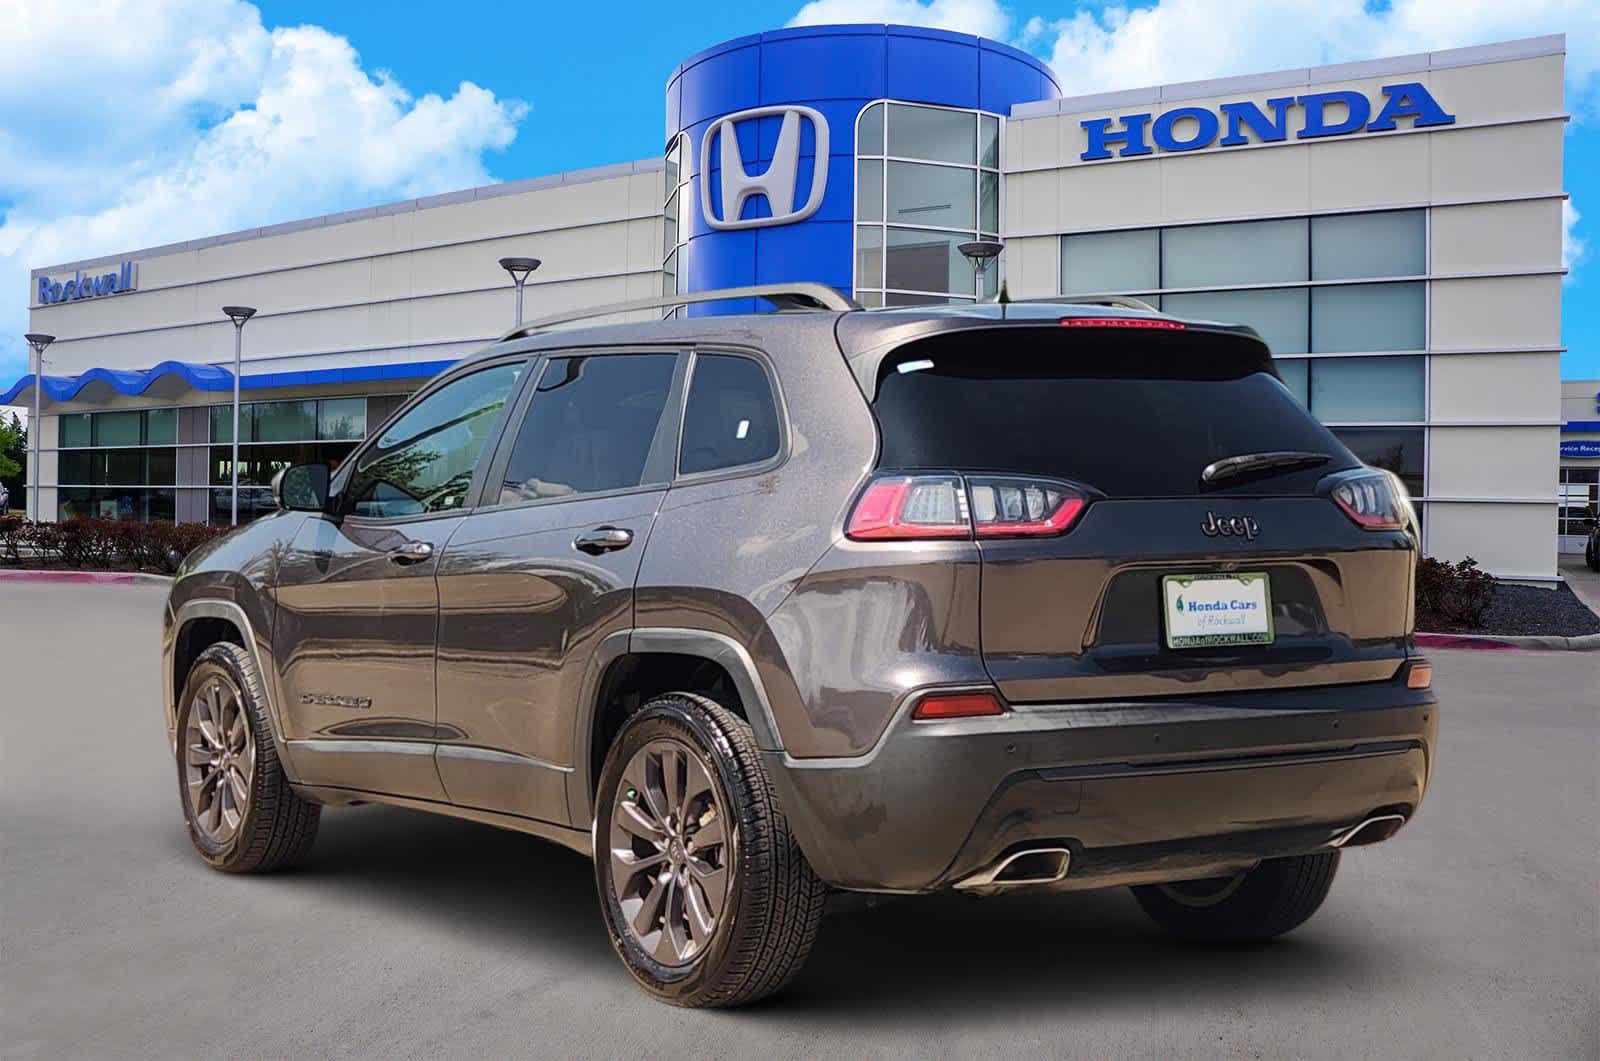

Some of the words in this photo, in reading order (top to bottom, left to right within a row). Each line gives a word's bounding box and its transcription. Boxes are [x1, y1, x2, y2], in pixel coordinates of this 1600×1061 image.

[1080, 82, 1456, 161] HONDA
[39, 261, 133, 304] Rockwall
[1200, 511, 1261, 540] Jeep
[1188, 600, 1228, 612] Honda
[1230, 599, 1257, 610] Cars
